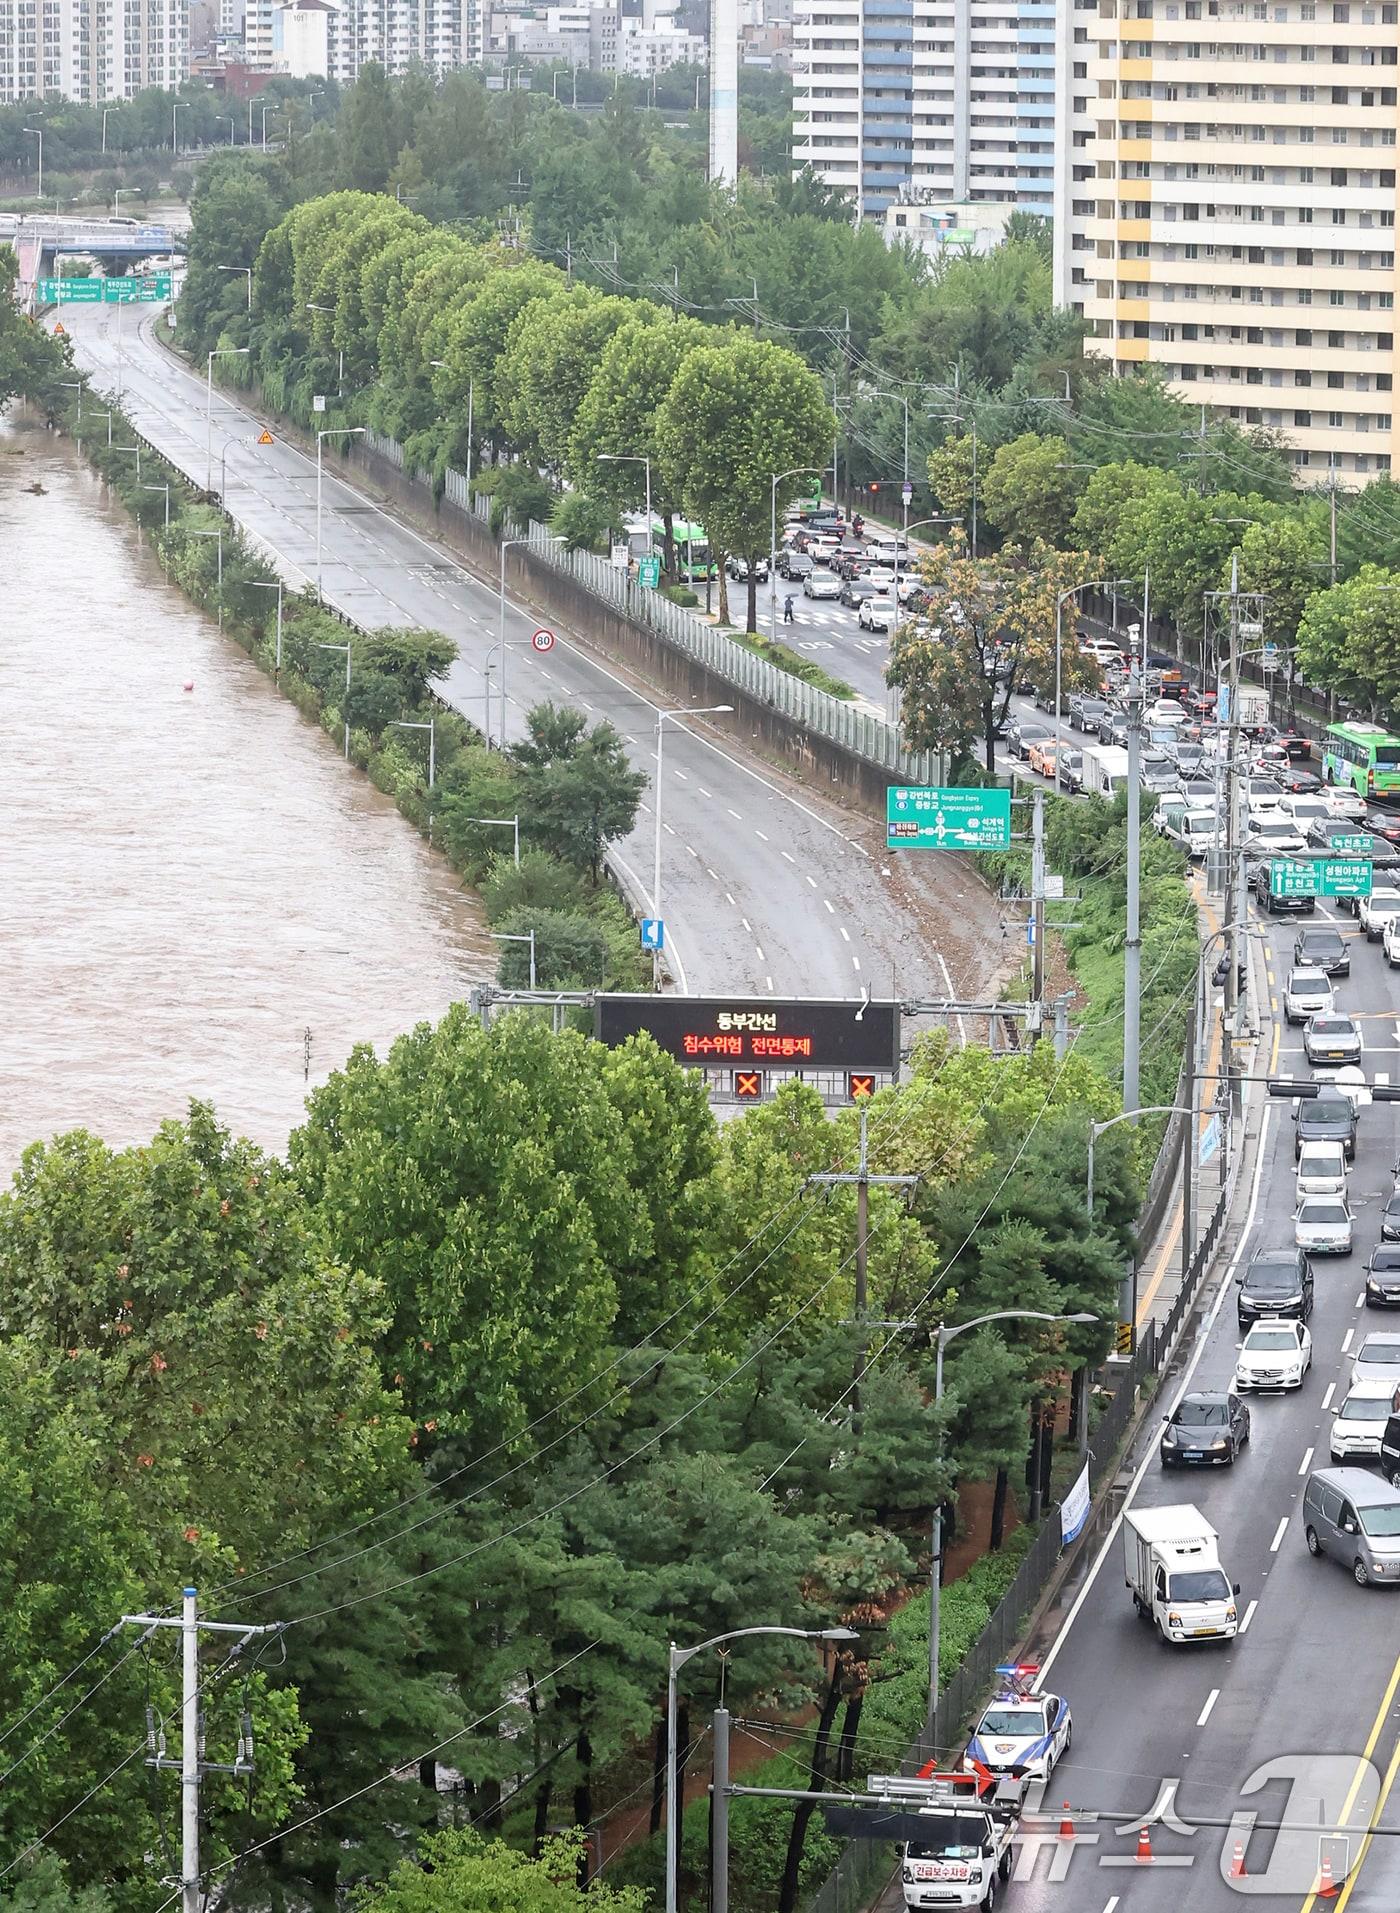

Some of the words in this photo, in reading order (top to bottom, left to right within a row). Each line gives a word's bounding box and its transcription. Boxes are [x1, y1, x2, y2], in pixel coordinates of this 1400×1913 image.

[537, 636, 550, 646] 80
[909, 791, 939, 800] 강변북로
[915, 800, 939, 810] 중랑교
[982, 817, 1004, 827] 석계역
[1334, 838, 1371, 848] 녹천초교
[1325, 865, 1369, 876] 성원아파트
[1355, 876, 1365, 884] Apt
[716, 1012, 777, 1031] 동부간선
[683, 1034, 742, 1055] 침수위험
[751, 1035, 811, 1057] 전면통제
[915, 1864, 969, 1878] 긴급보수차량
